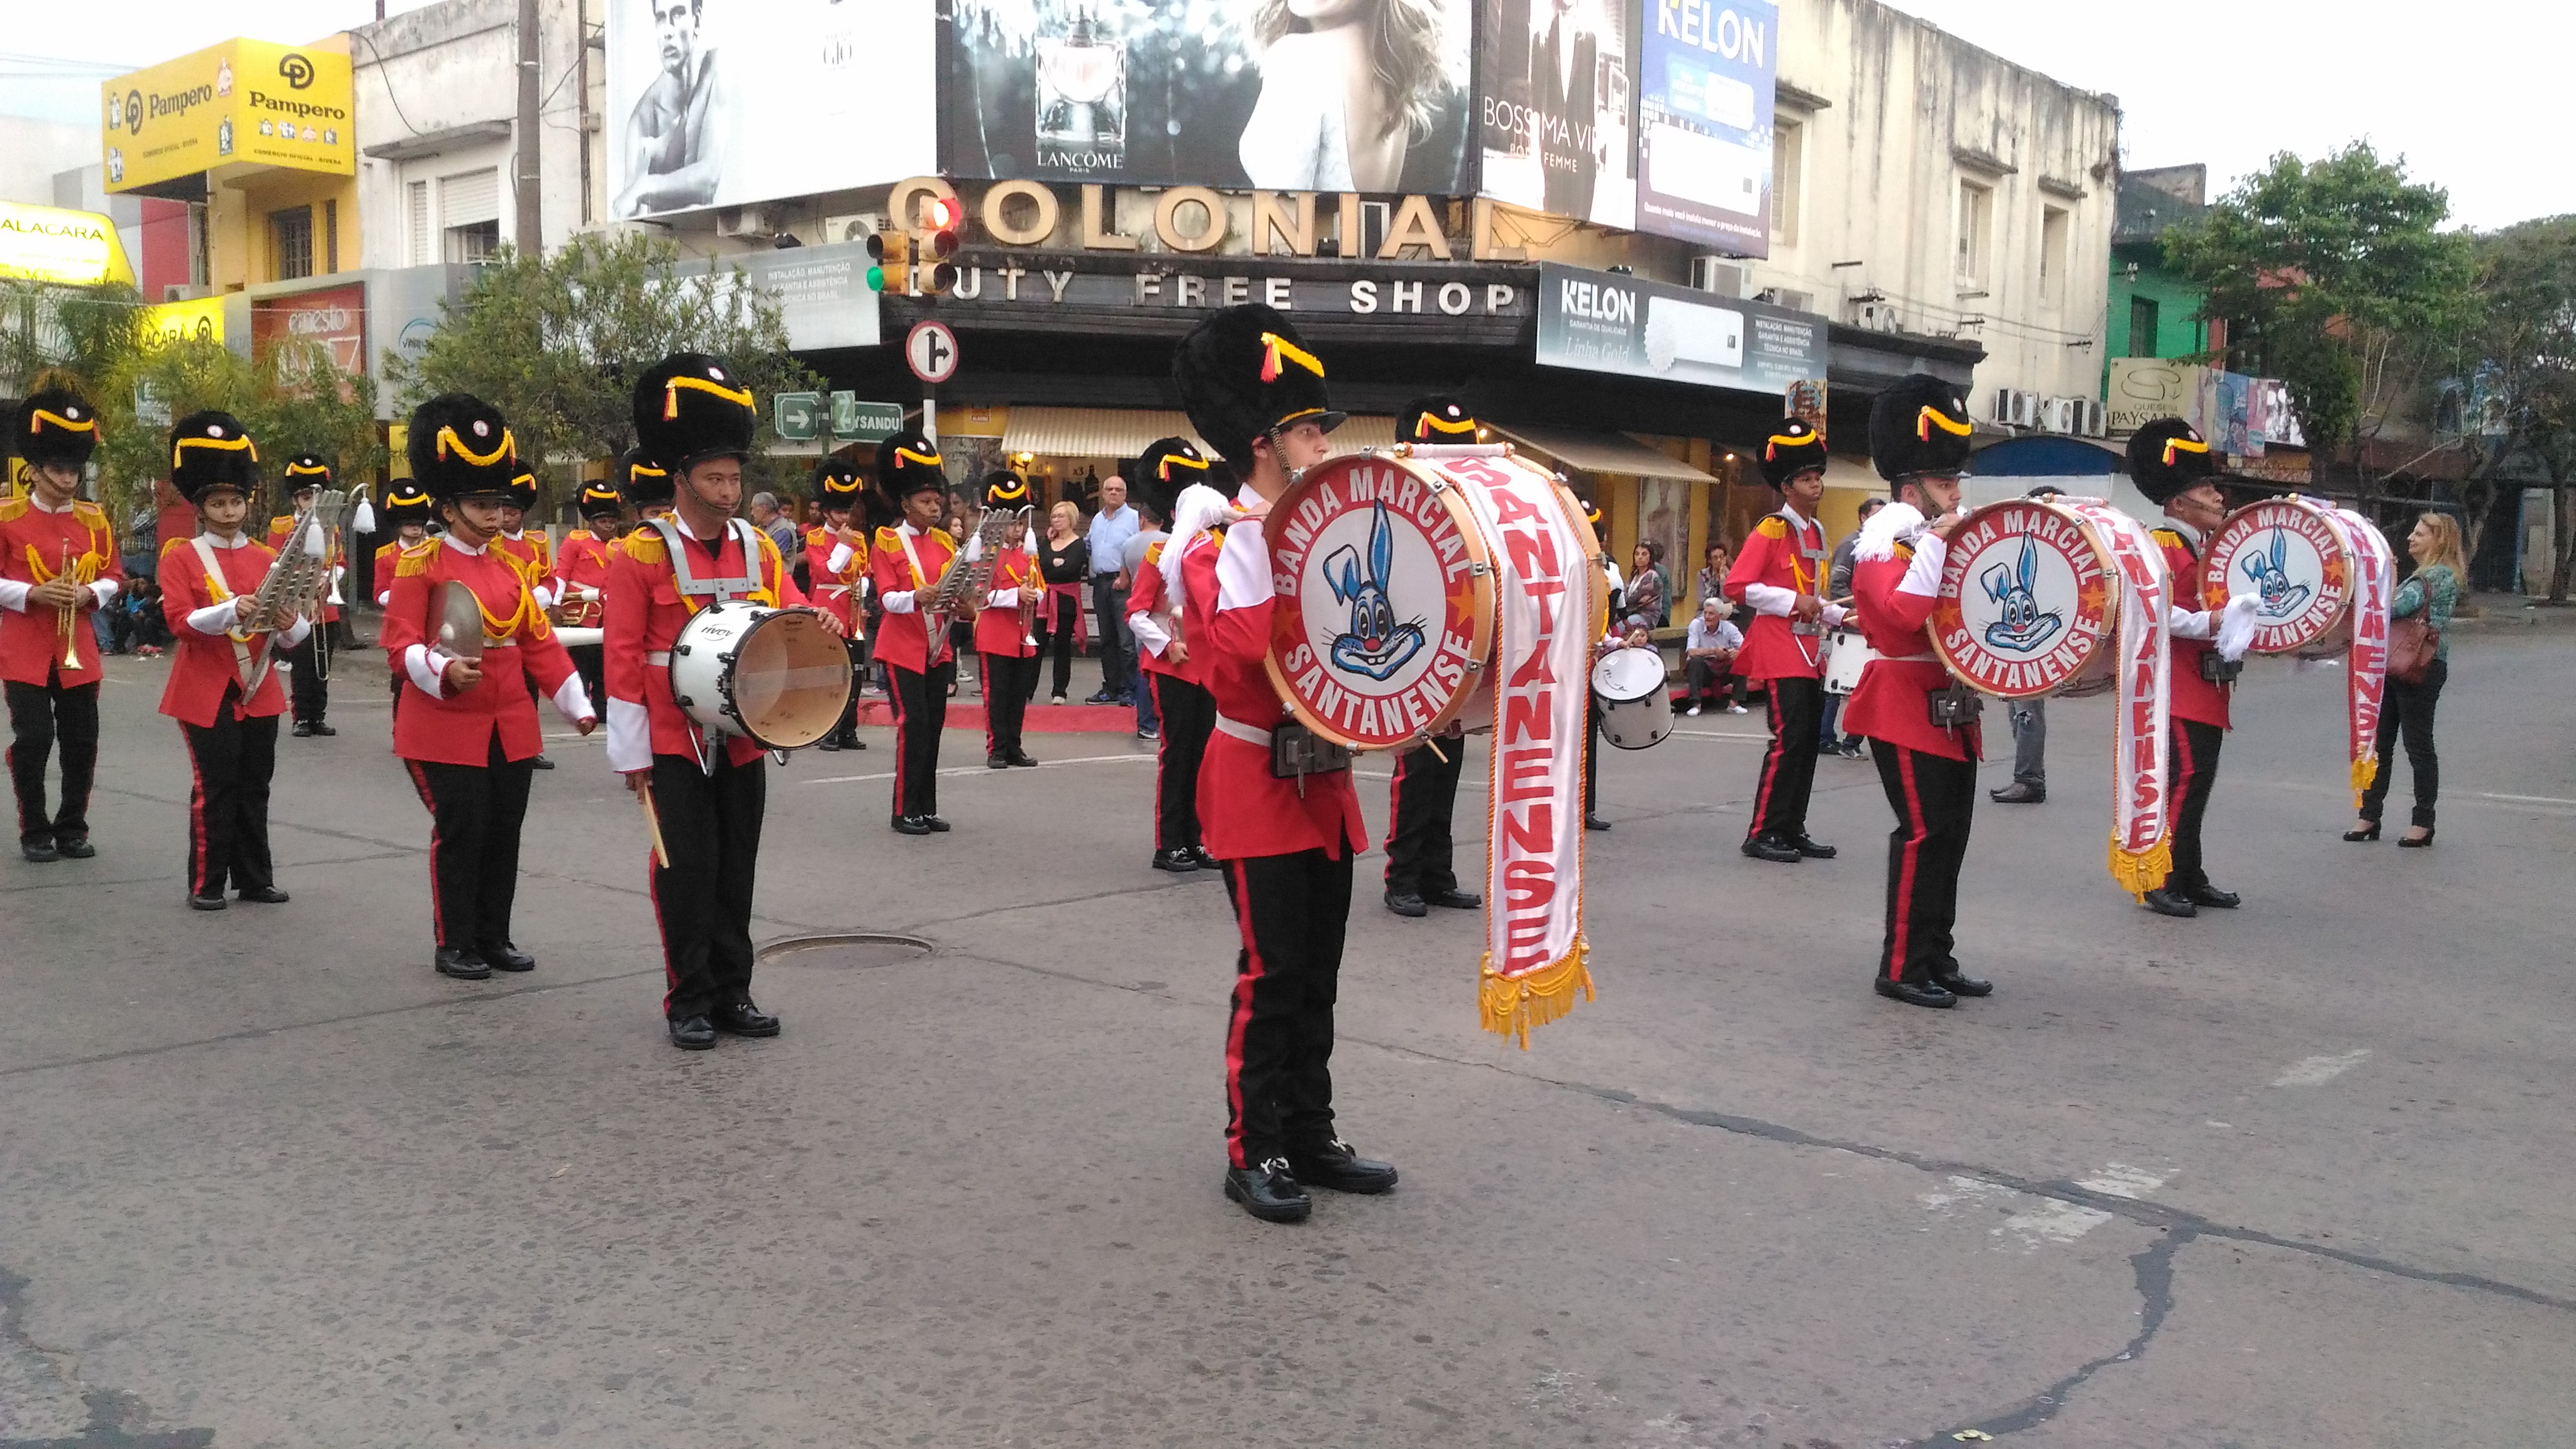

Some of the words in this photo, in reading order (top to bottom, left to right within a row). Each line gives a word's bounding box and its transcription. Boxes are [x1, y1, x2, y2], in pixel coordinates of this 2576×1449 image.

[1658, 0, 1765, 69] KELON
[149, 84, 213, 119] Pampero
[249, 90, 346, 120] Pampero
[1541, 111, 1572, 148] MA
[254, 148, 287, 157] COMERCIO
[319, 157, 342, 165] RIVERA
[1038, 150, 1123, 169] LANCÔME
[1544, 152, 1577, 173] FEMME
[889, 176, 1526, 261] COLONIAL
[1136, 274, 1291, 310] FREE
[1350, 280, 1514, 315] SHOP
[1562, 278, 1636, 324] KELON
[289, 304, 347, 333] ernesto
[1569, 319, 1593, 330] GARANTIA
[1594, 323, 1600, 332] DE
[1601, 325, 1627, 336] QUALIDADE
[1565, 337, 1599, 358] Linha
[1602, 342, 1629, 362] Gold
[855, 415, 899, 430] YSANDU
[1273, 482, 1342, 597] BANDA
[1348, 467, 1470, 584] MARCIAL
[2207, 521, 2253, 583] BANDA
[2257, 507, 2340, 561] MARCIAL
[1938, 521, 1997, 599] BANDA
[2003, 509, 2102, 586] MARCIAL
[2254, 584, 2342, 647] TANENSE
[1946, 614, 2101, 689] SANTANENSE
[1285, 630, 1474, 736] SANTANENSE
[1444, 456, 1567, 976] SANTANENSE
